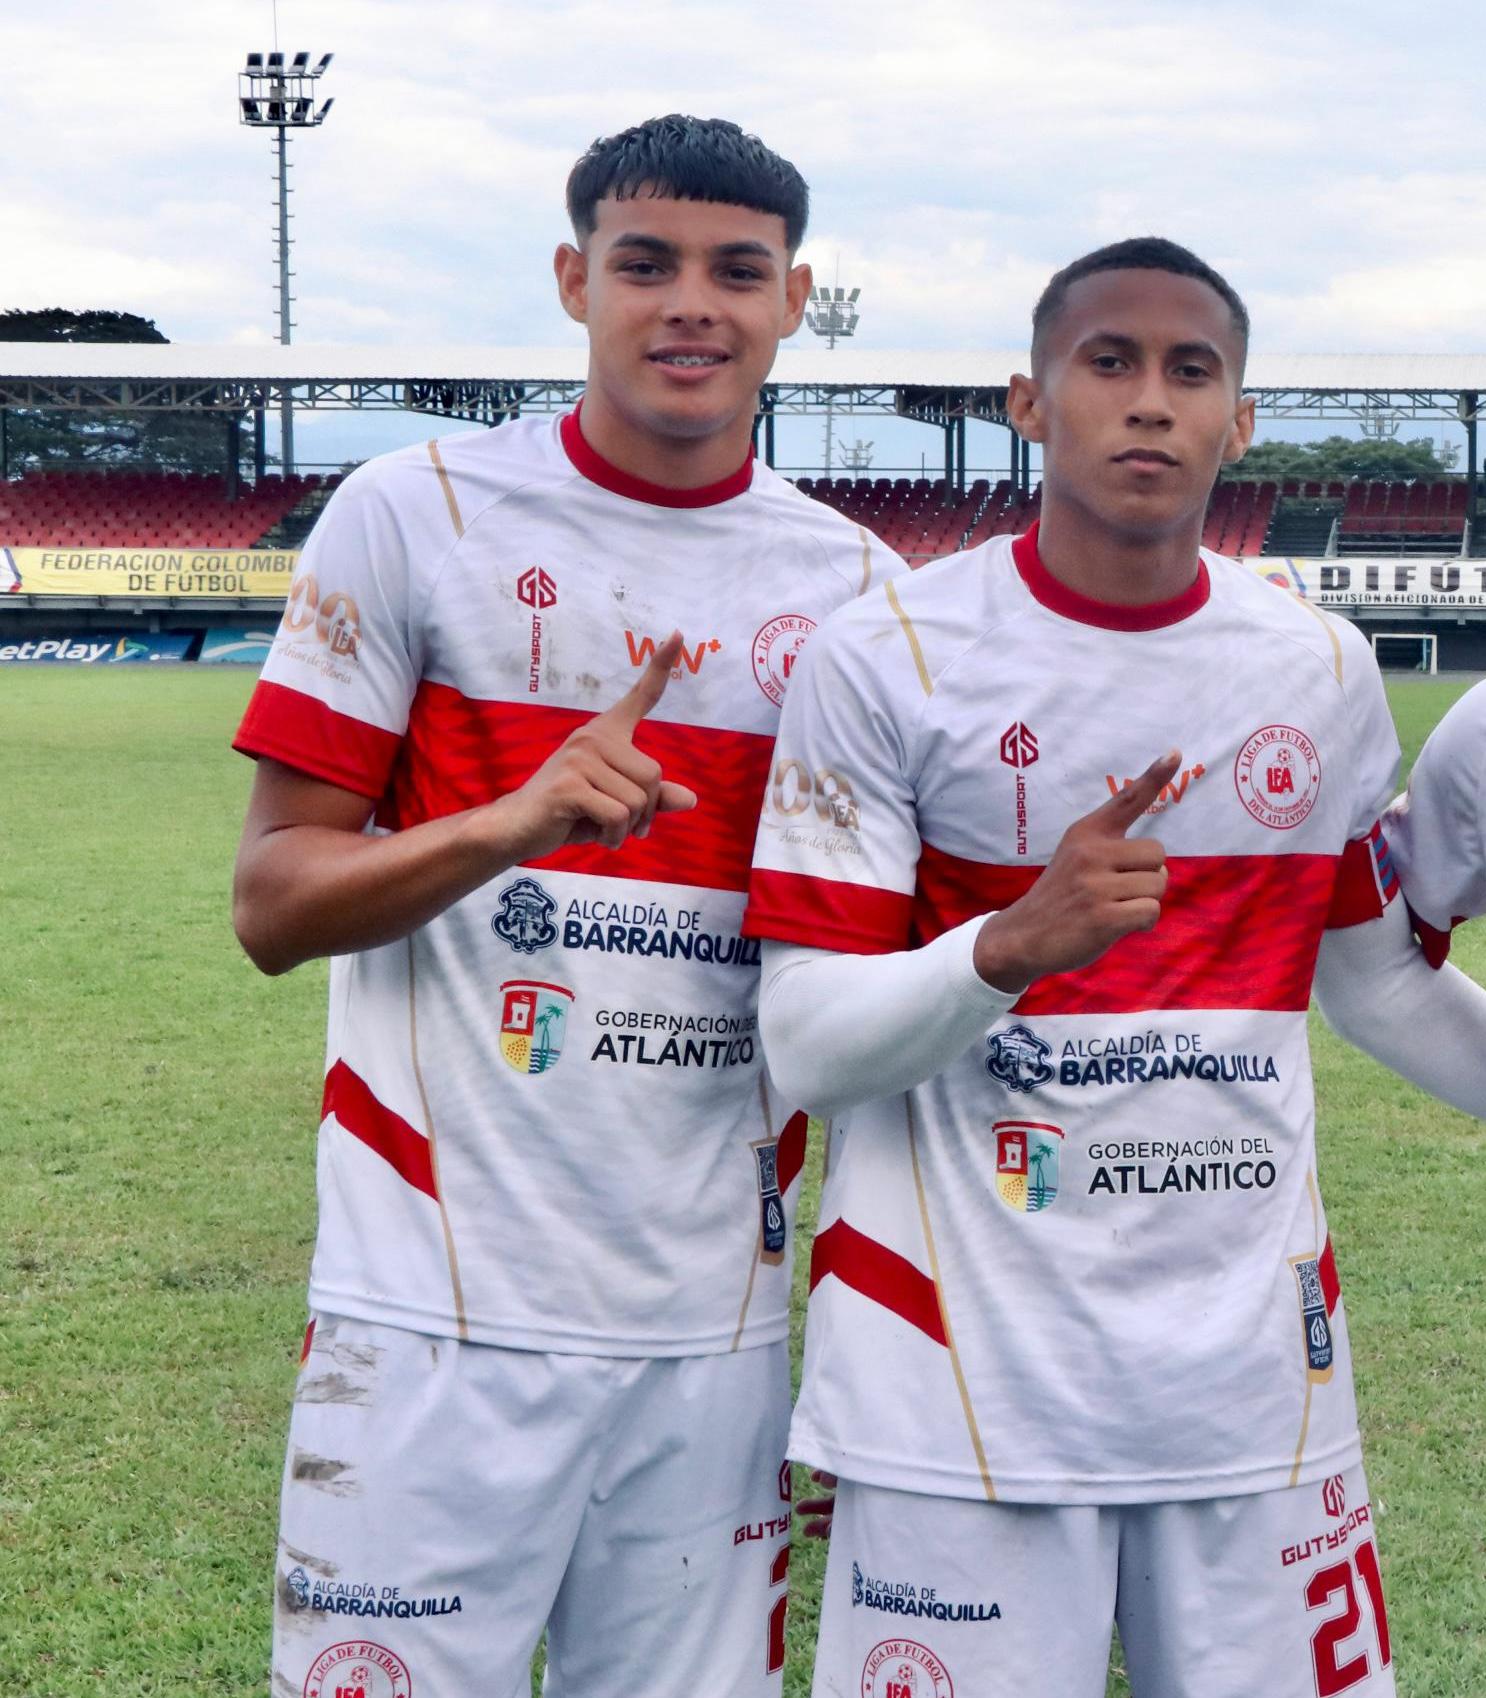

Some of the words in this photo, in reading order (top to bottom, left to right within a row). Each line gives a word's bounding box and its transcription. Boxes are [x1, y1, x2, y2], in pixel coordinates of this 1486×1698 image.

[41, 553, 183, 572] FEDERACION
[128, 574, 156, 592] DE
[1385, 594, 1465, 605] AFICIONADA
[1469, 595, 1485, 605] DE
[759, 626, 780, 650] LIGA
[779, 619, 796, 630] DE
[529, 613, 542, 693] GUTYSPORT
[1241, 740, 1263, 769] LIGA
[1262, 729, 1278, 742] DE
[1280, 730, 1314, 765] FUTBOL
[1016, 774, 1027, 855] GUTYSPORT
[1248, 799, 1265, 819] DEL
[566, 899, 668, 928] ALCALDÍA
[677, 910, 700, 931] DE
[595, 1010, 740, 1034] GOBERNACIÓN
[591, 1031, 755, 1069] ATLÁNTICO
[1061, 1030, 1167, 1058] ALCALDÍA
[1175, 1034, 1203, 1053] DE
[1059, 1054, 1280, 1087] BARRANQUILLA
[1088, 1135, 1234, 1160] GOBERNACIÓN
[1241, 1138, 1274, 1154] DEL
[1088, 1156, 1277, 1195] ATLÁNTICO
[313, 1580, 375, 1599] ALCALDÍA
[382, 1586, 400, 1600] DE
[866, 1576, 916, 1599] ALCALDÍA
[921, 1587, 936, 1601] DE
[311, 1593, 462, 1619] BARRANQUILLA
[865, 1590, 1002, 1622] BARRANQUILLA
[1304, 1536, 1392, 1698] 21
[313, 1654, 336, 1682] LIGA
[336, 1646, 356, 1659] DE
[359, 1645, 404, 1684] FUTBOL
[867, 1650, 886, 1677] LIGA
[885, 1643, 901, 1656] DE
[904, 1644, 944, 1685] FUTBOL
